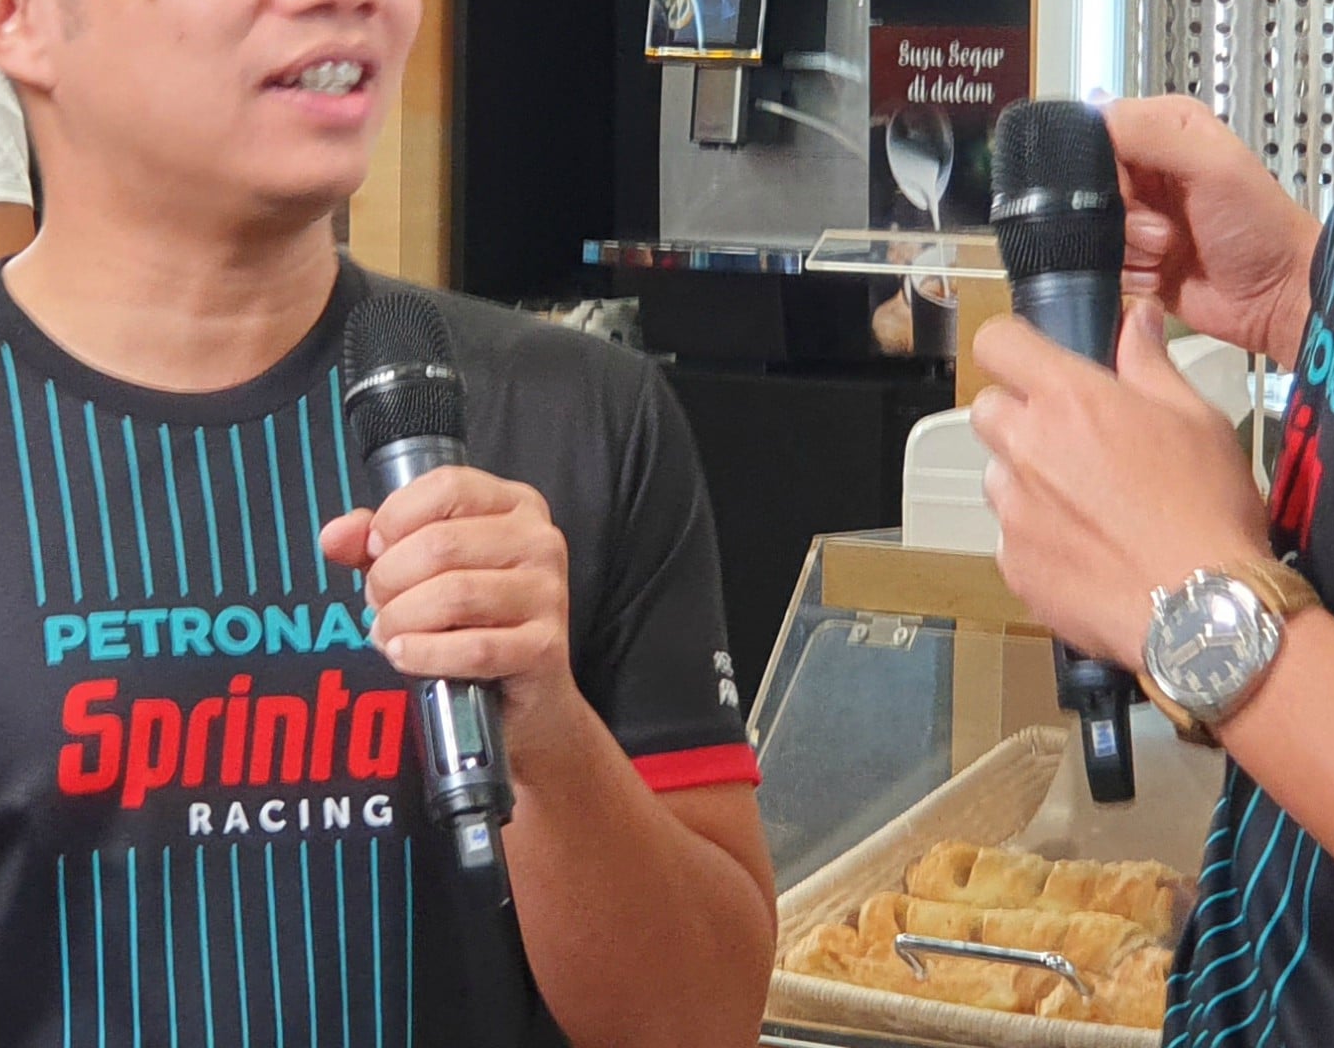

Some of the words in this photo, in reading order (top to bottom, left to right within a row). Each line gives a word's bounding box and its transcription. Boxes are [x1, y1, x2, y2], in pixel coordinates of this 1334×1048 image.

[898, 38, 945, 72] Susu
[947, 38, 1005, 77] Segar
[908, 74, 927, 104] di
[930, 74, 995, 104] dalam
[57, 668, 409, 810] Sprinta
[187, 793, 395, 837] RACING
